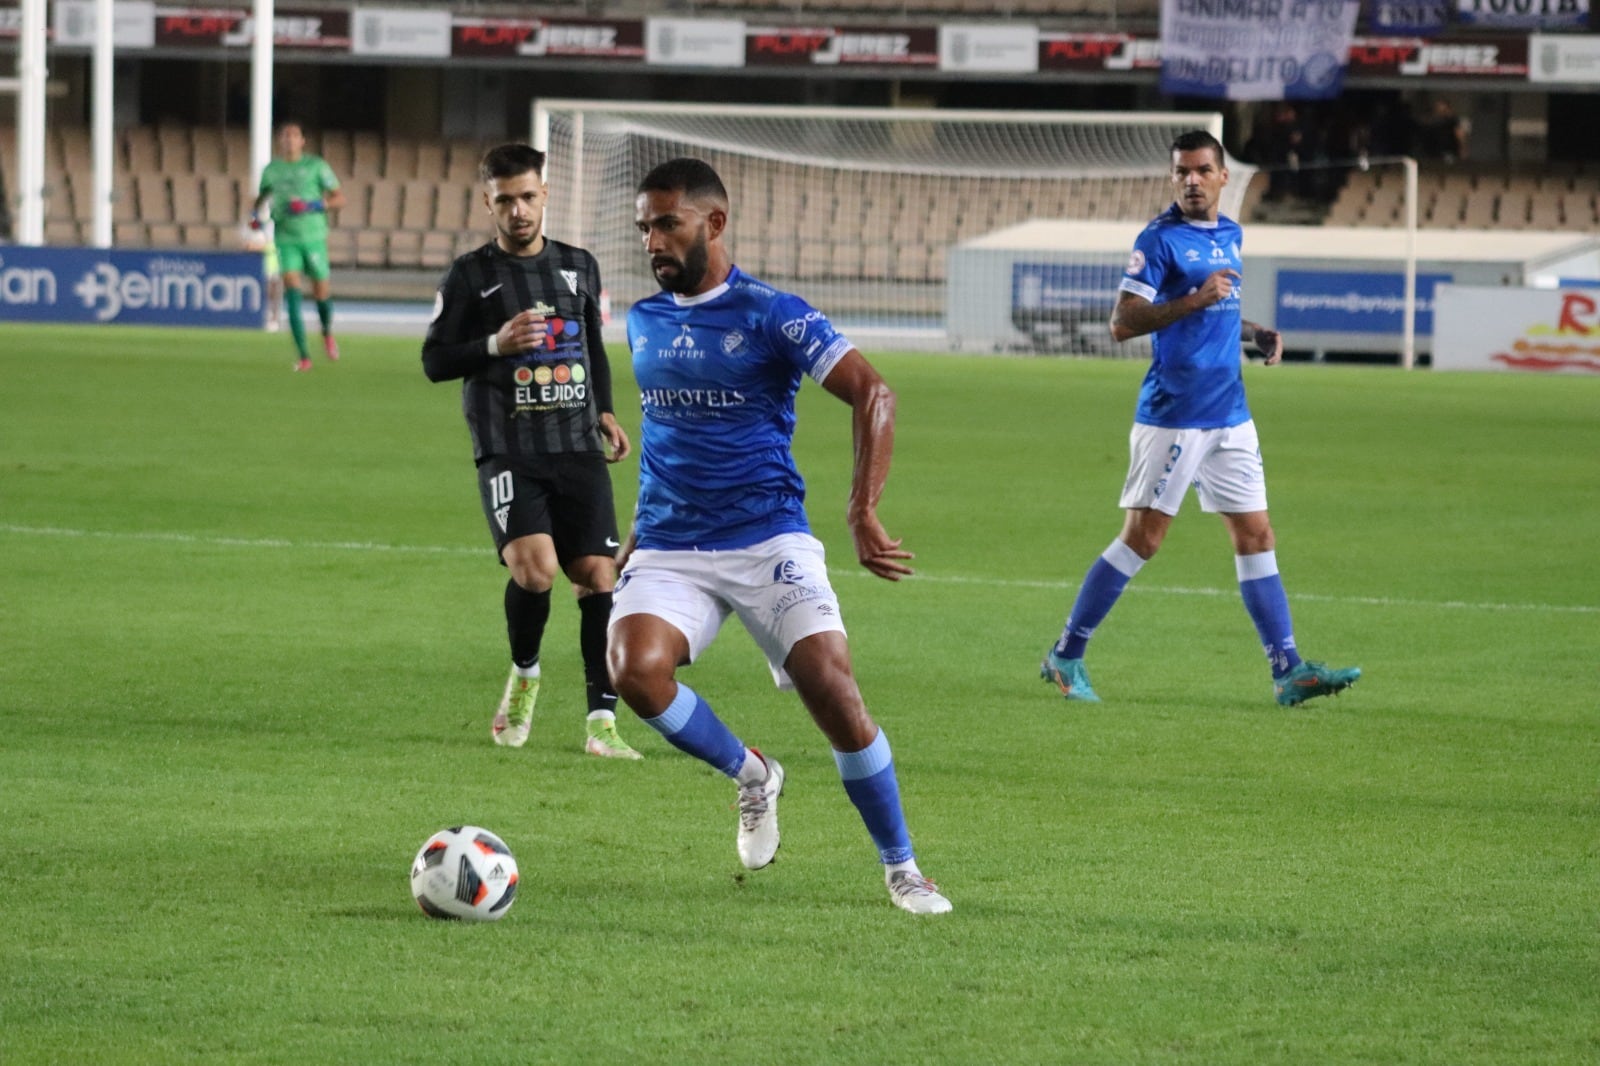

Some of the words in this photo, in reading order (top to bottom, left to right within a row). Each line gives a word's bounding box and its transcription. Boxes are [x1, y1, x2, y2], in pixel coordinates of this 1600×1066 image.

[518, 24, 618, 56] JEREZ
[811, 33, 911, 64] JEREZ
[1400, 43, 1499, 74] JEREZ
[1558, 291, 1600, 336] R
[679, 350, 706, 359] PEPE
[515, 387, 537, 404] EL
[541, 384, 586, 401] EJIDO
[489, 470, 514, 507] 10
